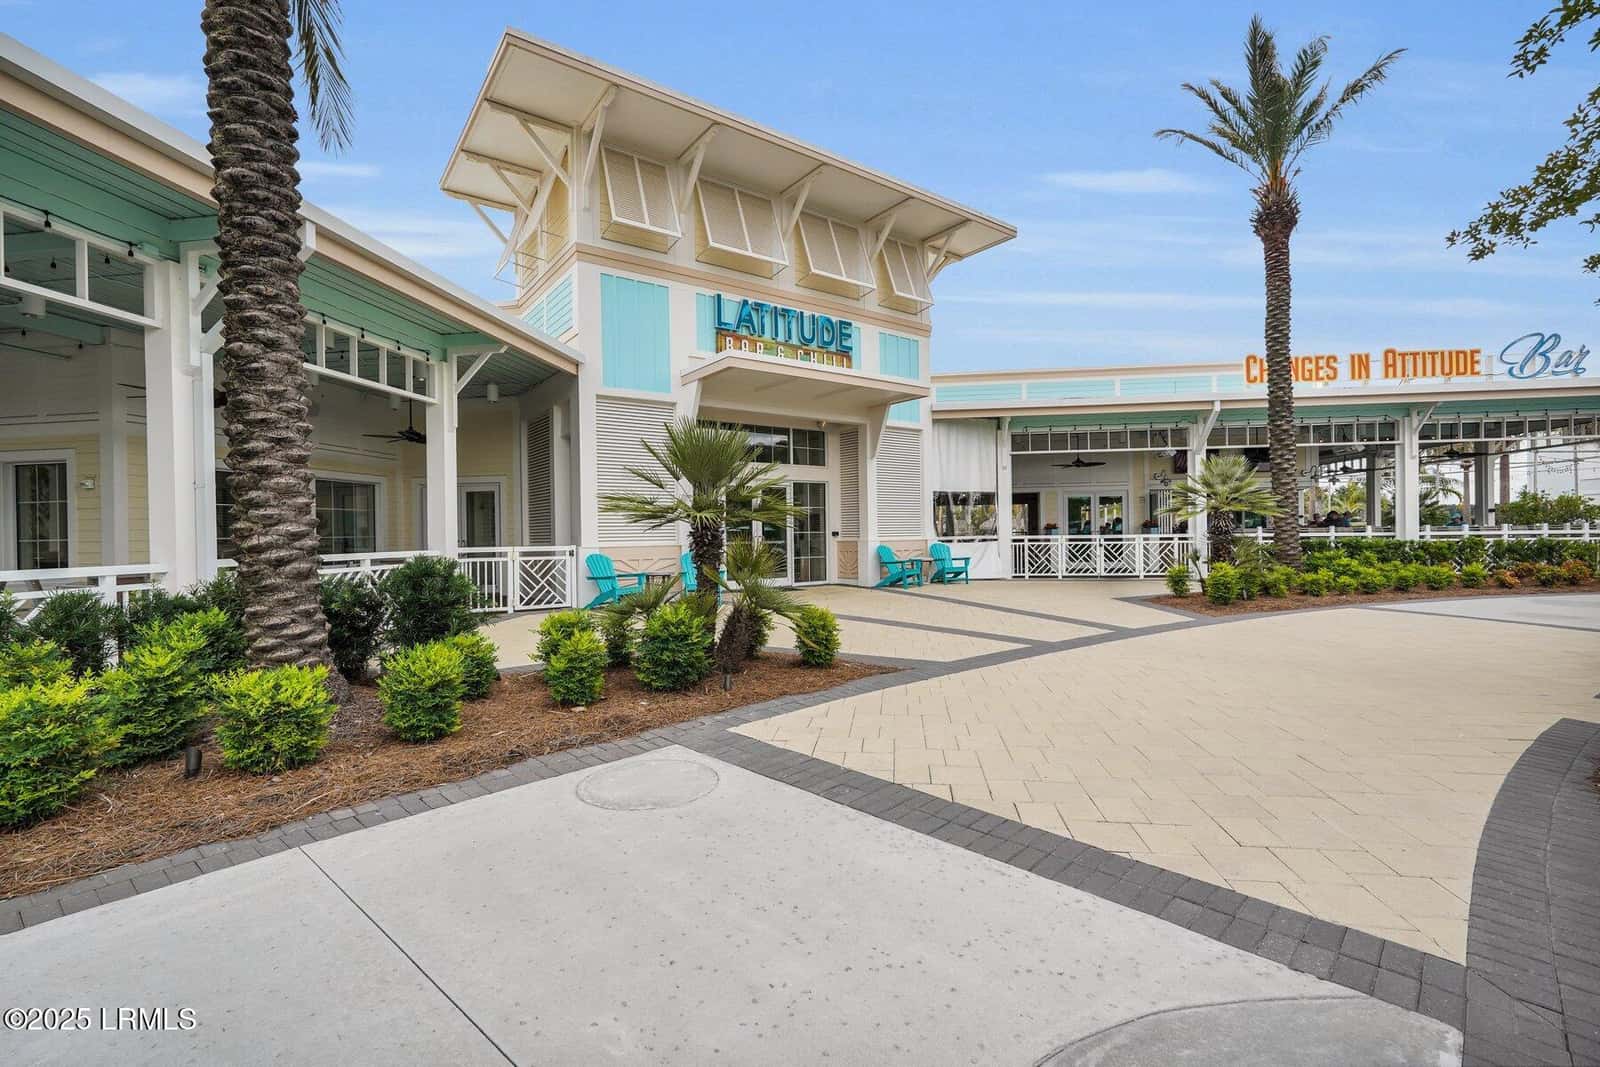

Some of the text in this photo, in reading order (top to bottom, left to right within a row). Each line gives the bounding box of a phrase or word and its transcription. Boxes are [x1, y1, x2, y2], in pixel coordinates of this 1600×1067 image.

[715, 293, 853, 353] LATITUDE
[1246, 332, 1590, 383] CHNGES IN ATTITUDE Bar
